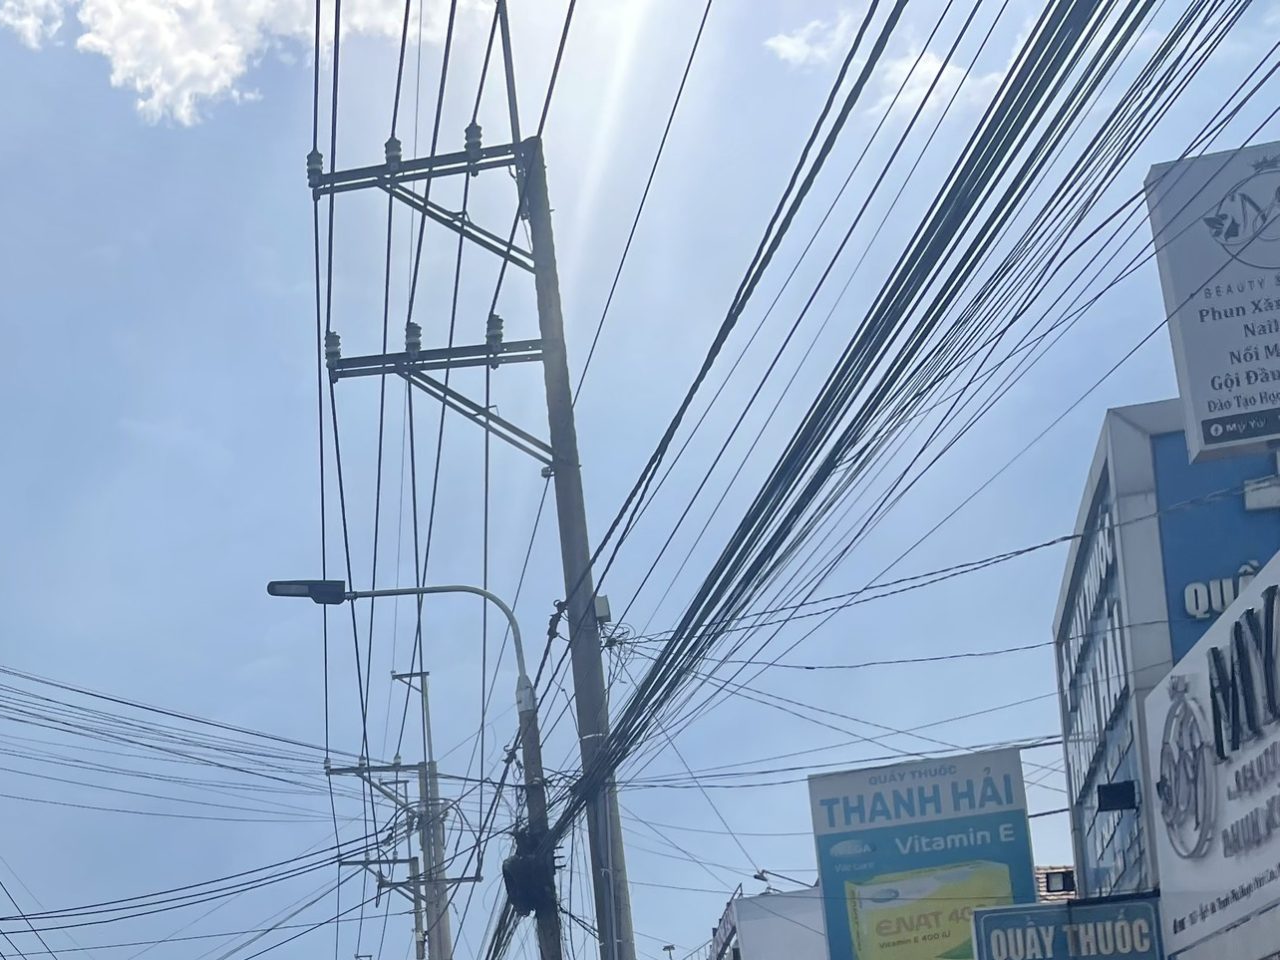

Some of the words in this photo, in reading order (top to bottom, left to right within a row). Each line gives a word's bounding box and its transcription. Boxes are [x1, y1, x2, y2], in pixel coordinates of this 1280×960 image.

[1204, 278, 1266, 299] BEAUTY
[1199, 304, 1246, 322] Phun
[1229, 345, 1260, 365] Nối
[1210, 372, 1241, 392] Gội
[820, 783, 942, 828] THANH
[950, 766, 1014, 812] HẢI
[895, 827, 992, 855] Vitamin
[999, 823, 1015, 842] E
[1063, 908, 1151, 957] THUỐC
